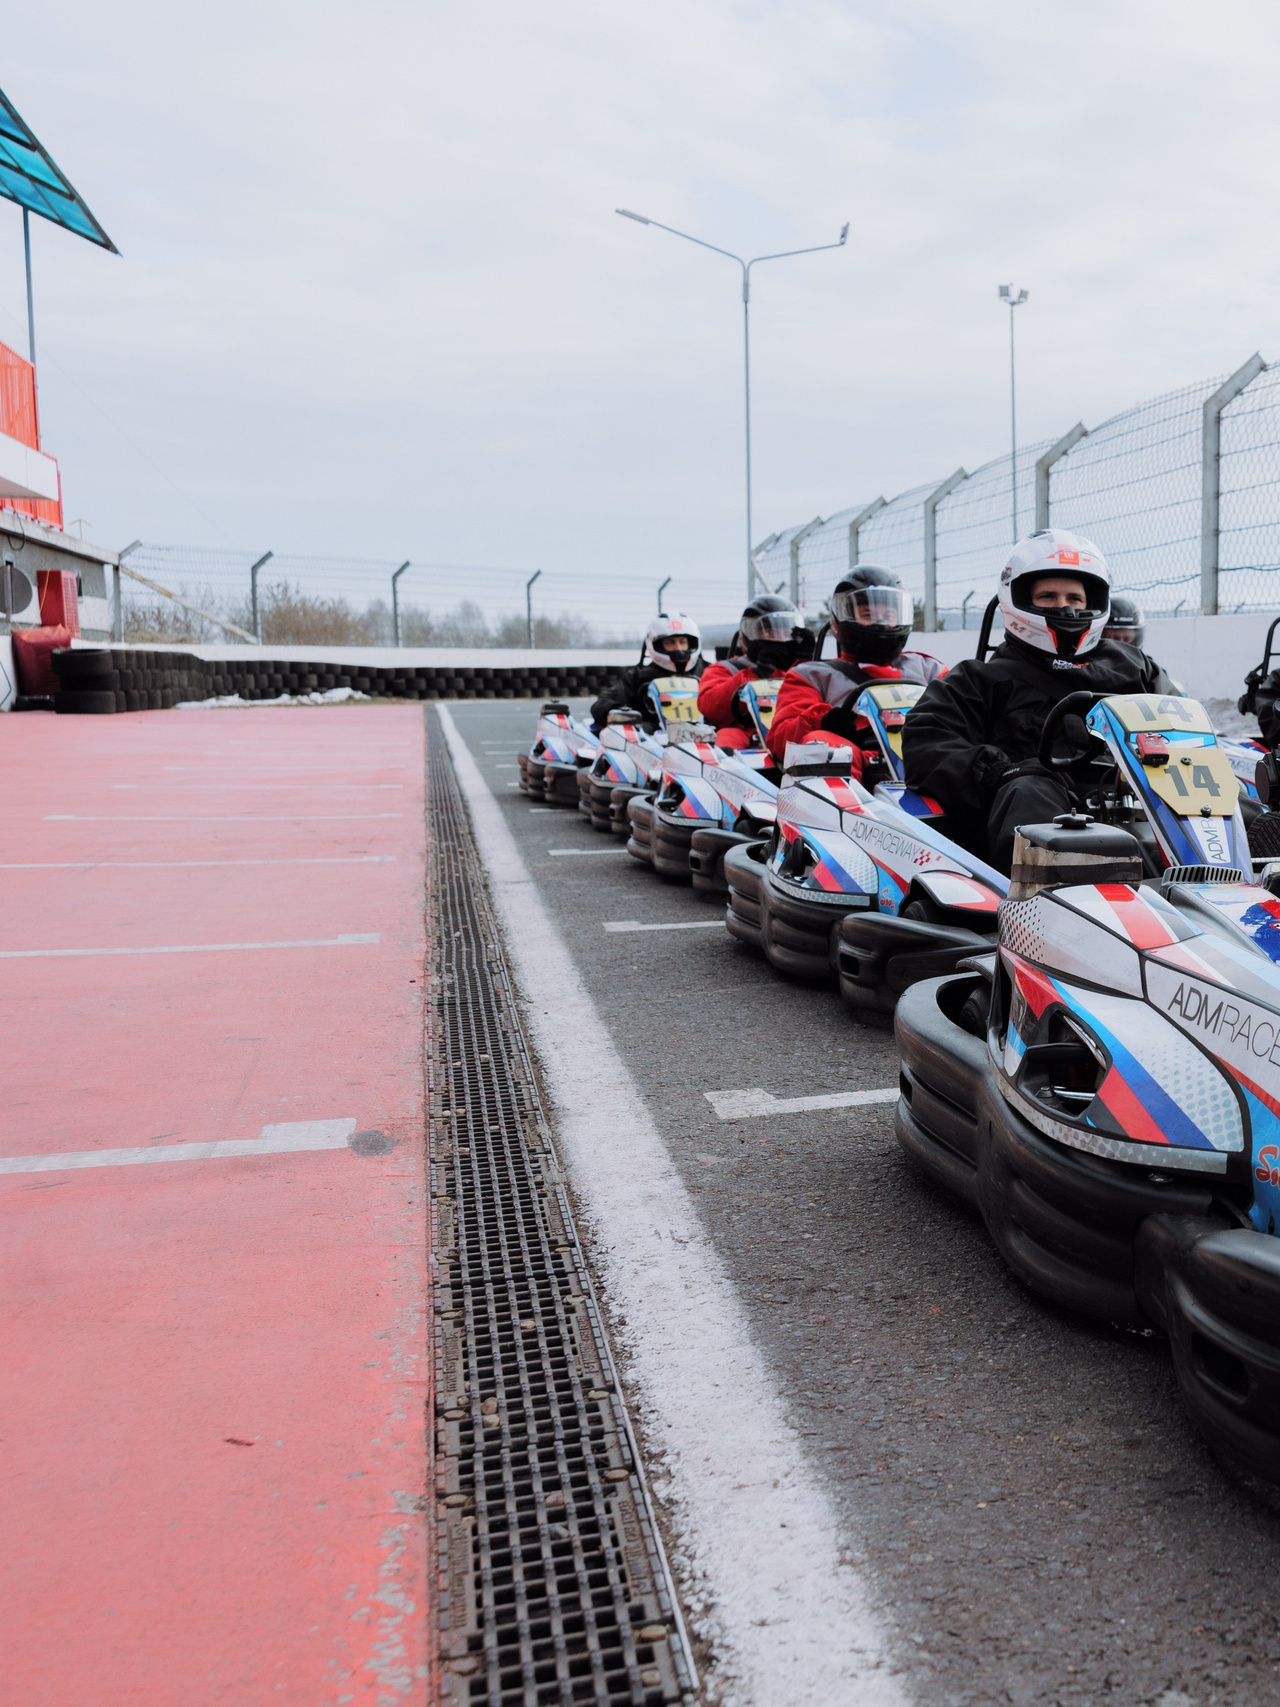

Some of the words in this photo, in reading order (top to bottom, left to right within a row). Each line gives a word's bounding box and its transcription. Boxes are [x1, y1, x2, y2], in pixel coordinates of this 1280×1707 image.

[673, 706, 692, 719] 11
[1124, 696, 1194, 723] 14
[1164, 765, 1221, 797] 14
